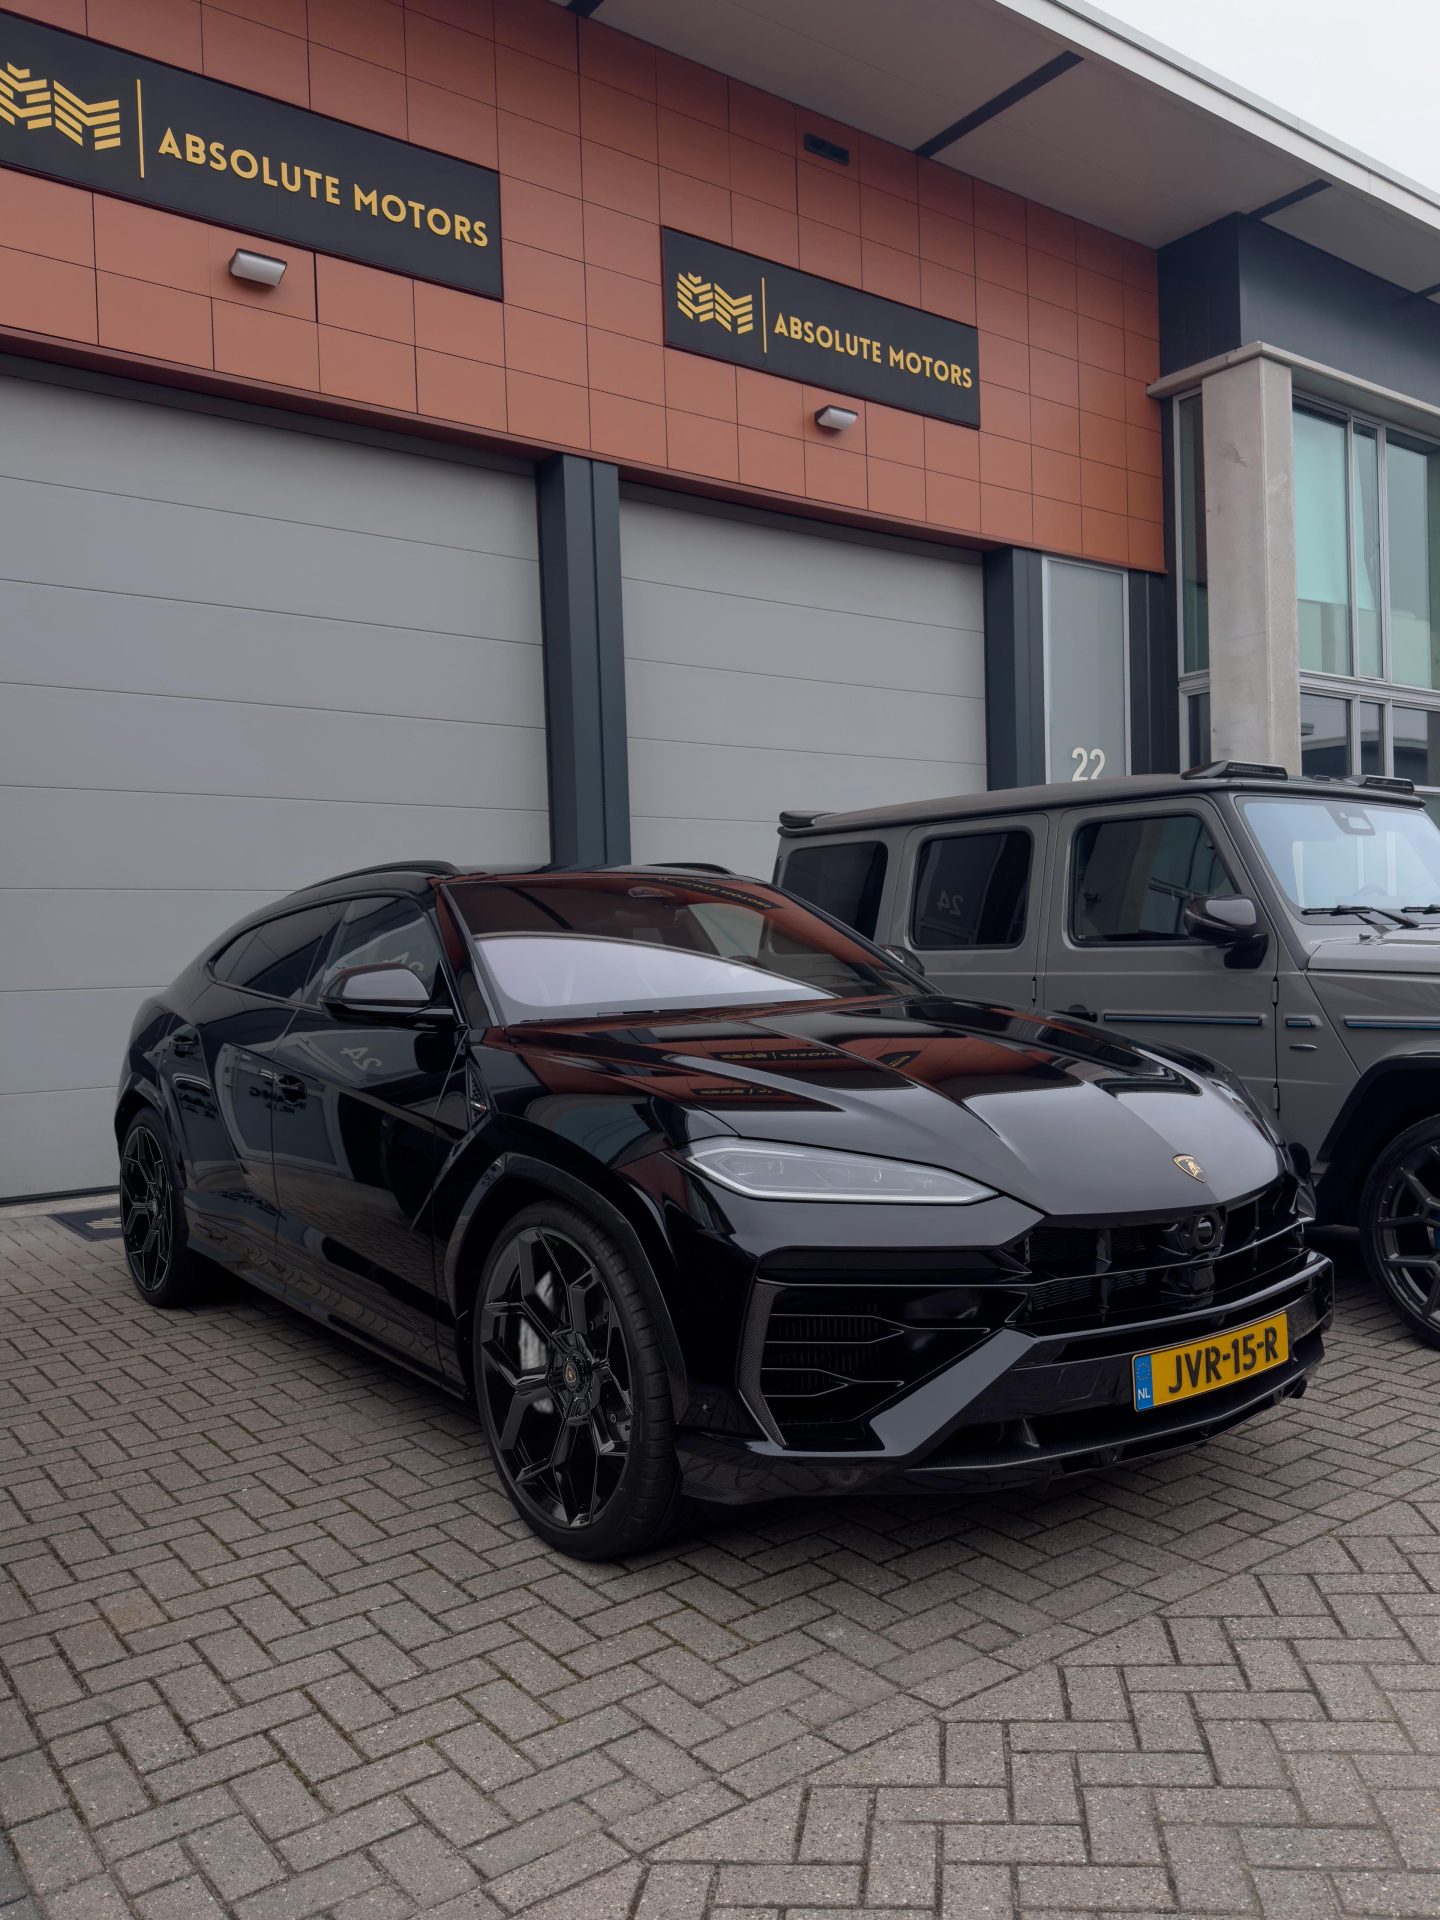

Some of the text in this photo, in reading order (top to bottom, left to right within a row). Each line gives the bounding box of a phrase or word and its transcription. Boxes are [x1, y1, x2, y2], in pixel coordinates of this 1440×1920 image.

[158, 127, 488, 247] ABSOLUTE MOTORS
[774, 312, 973, 389] ABSOLUTE MOTORS
[1072, 747, 1105, 781] 22
[1137, 1326, 1279, 1400] NL JVR-15-R
